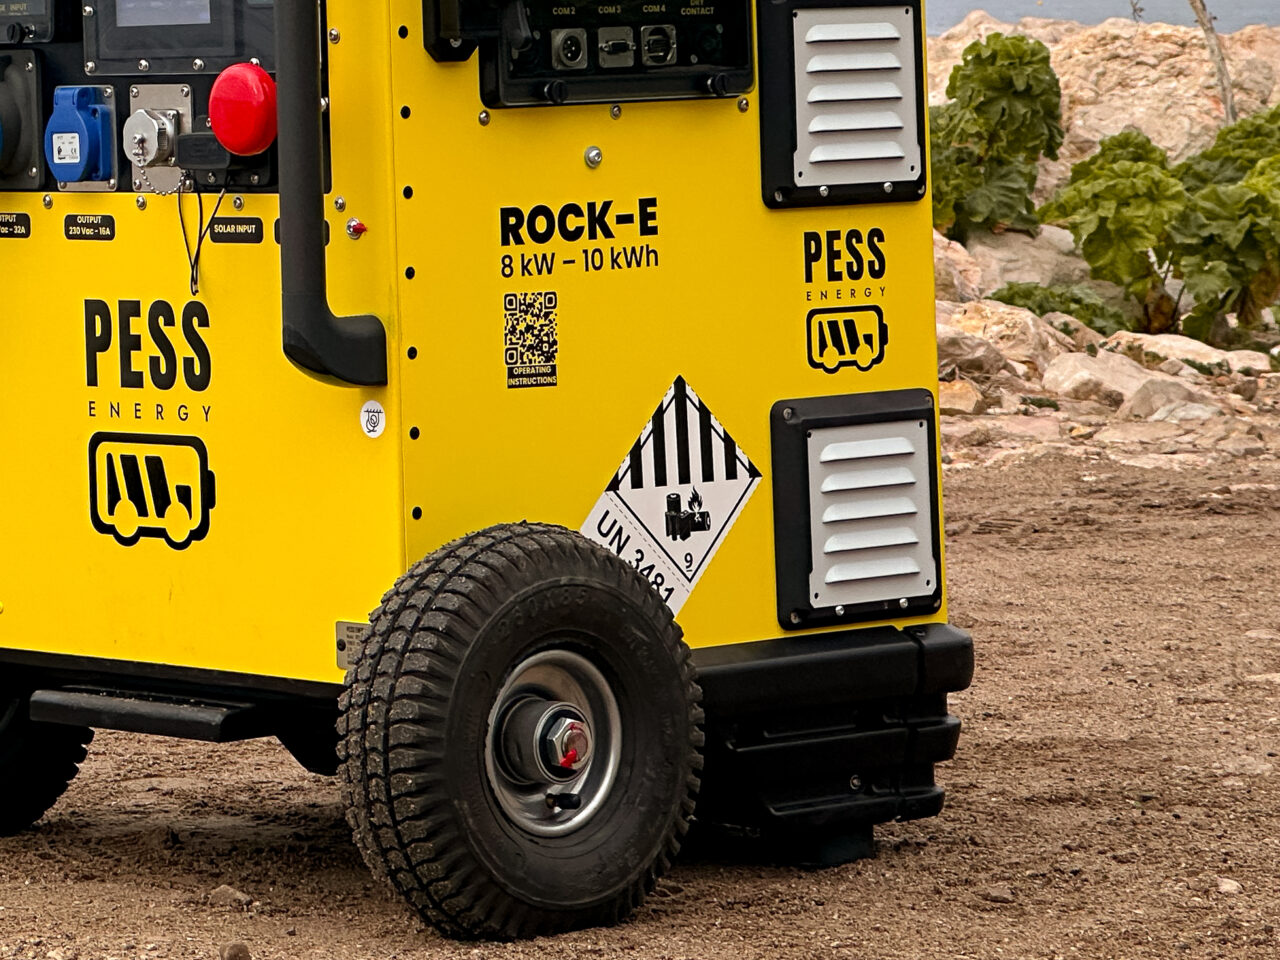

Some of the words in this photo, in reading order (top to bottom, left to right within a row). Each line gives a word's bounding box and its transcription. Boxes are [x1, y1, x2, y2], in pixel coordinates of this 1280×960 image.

[9, 3, 27, 11] INPUT
[552, 7, 570, 15] COM
[570, 7, 576, 15] 2
[598, 6, 615, 14] COM
[642, 5, 660, 13] COM
[660, 4, 666, 12] 4
[680, 7, 714, 15] CONTACT
[76, 215, 102, 224] OUTPUT
[500, 197, 659, 247] ROCK-E
[13, 225, 26, 234] 32A
[68, 226, 81, 235] 230
[99, 227, 111, 236] 16A
[213, 224, 235, 233] SOLAR
[236, 224, 256, 233] INPUT
[803, 227, 886, 283] PESS
[500, 254, 514, 278] 8
[520, 252, 556, 277] kW
[582, 247, 604, 272] 10
[610, 243, 659, 270] kWh
[806, 286, 886, 301] ENERGY
[84, 298, 212, 392] PESS
[513, 365, 552, 375] OPERATING
[508, 375, 557, 386] INSTRUCTIONS
[88, 400, 211, 422] ENERGY
[597, 509, 631, 557] UN
[684, 552, 694, 569] 9
